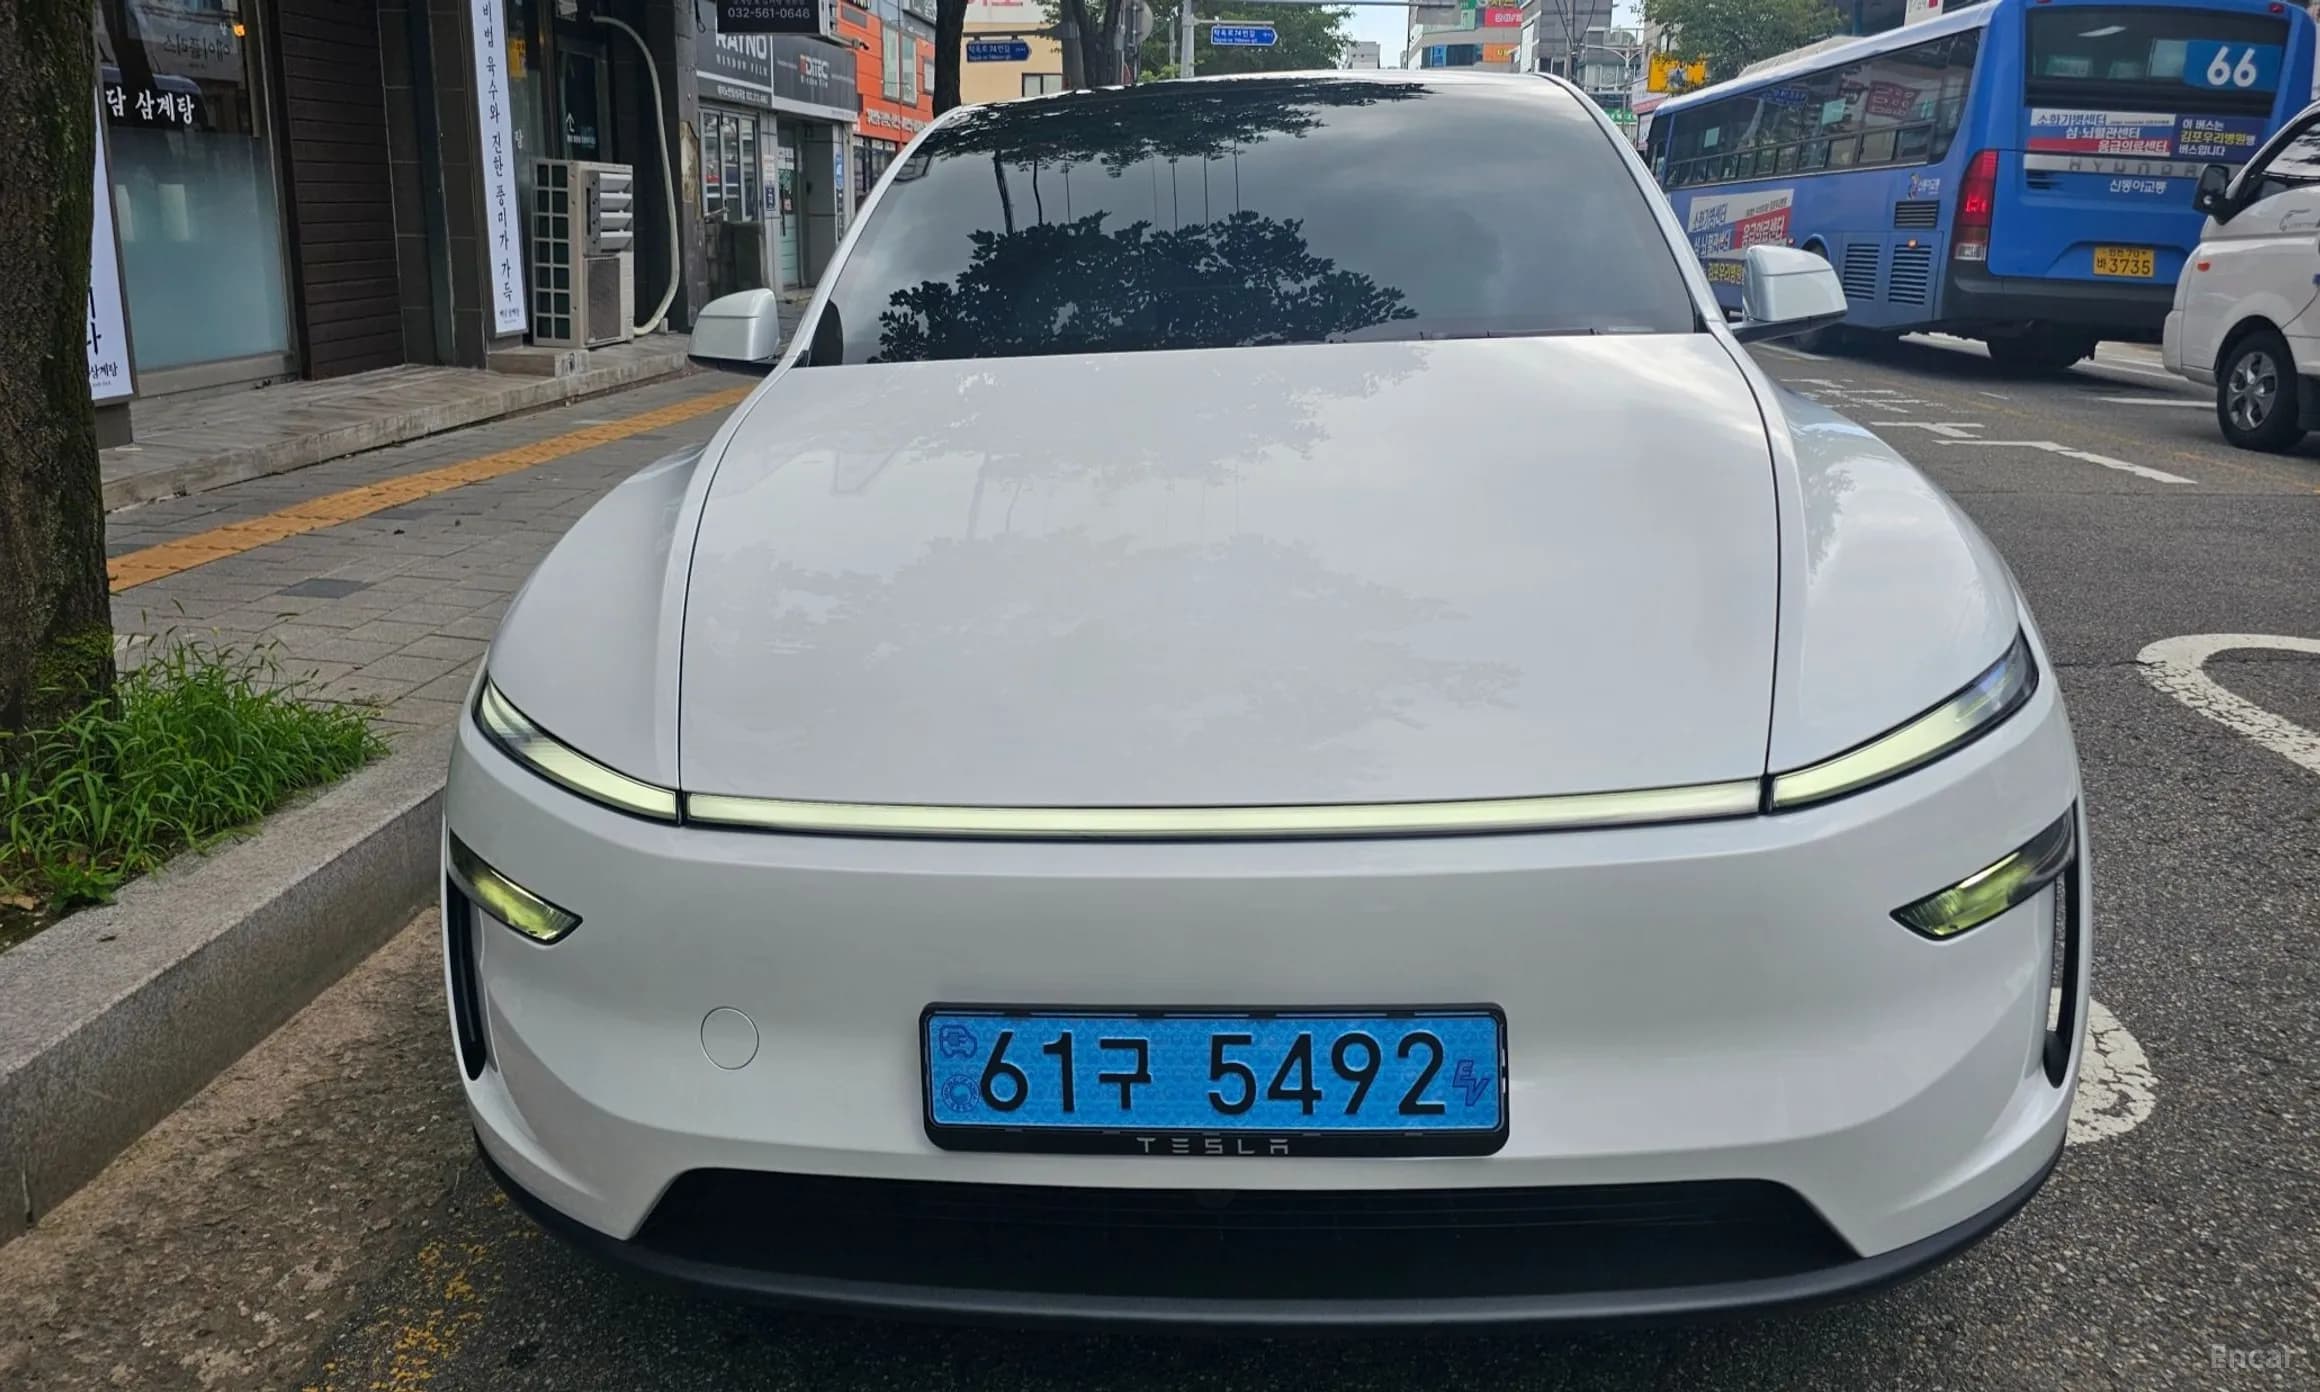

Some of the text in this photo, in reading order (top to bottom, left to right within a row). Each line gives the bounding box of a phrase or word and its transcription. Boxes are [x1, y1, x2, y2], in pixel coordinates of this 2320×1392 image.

[2206, 45, 2258, 88] 66
[486, 55, 500, 124] 육수와
[135, 90, 195, 125] 삼계탕
[2037, 113, 2107, 126] 소화기병센터
[2182, 118, 2193, 129] 이
[2195, 119, 2225, 131] 버스는
[492, 131, 503, 177] 진한
[2097, 140, 2168, 153] 응급의료센터
[2178, 144, 2226, 157] 버스입니다
[2068, 158, 2199, 177] HYUNDA
[496, 184, 510, 251] 풍미가
[501, 257, 513, 303] 가득
[2109, 258, 2151, 275] 3735
[980, 1030, 1152, 1114] 61구
[1207, 1031, 1446, 1116] 5492
[1135, 1136, 1290, 1155] TESLA
